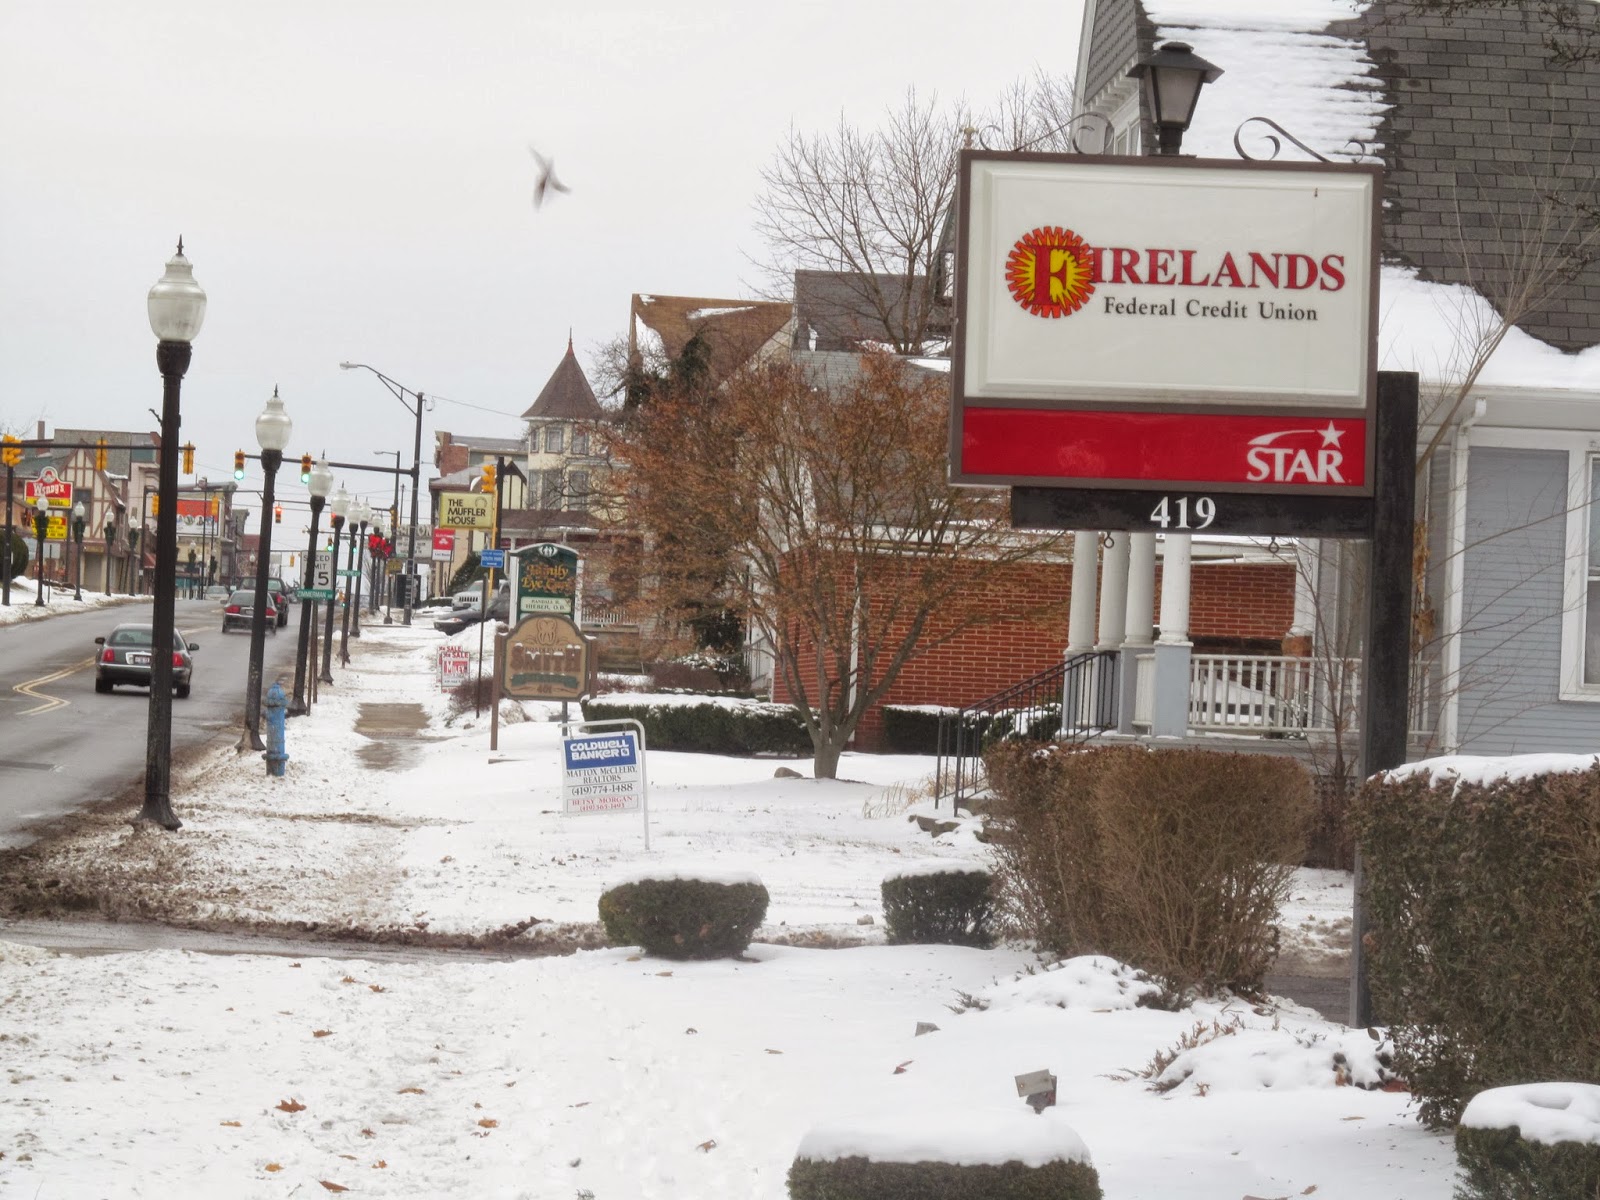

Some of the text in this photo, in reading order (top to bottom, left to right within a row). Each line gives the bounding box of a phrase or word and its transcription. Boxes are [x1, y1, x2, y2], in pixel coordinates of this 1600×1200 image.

[1023, 245, 1346, 306] FIRELANDS
[1104, 297, 1319, 321] Federal Credit Union
[1246, 446, 1346, 484] STAR
[448, 498, 463, 507] THE
[447, 508, 486, 517] MUFFLER
[1150, 496, 1216, 530] 419
[447, 516, 476, 525] HOUSE
[570, 739, 629, 752] COLDWELL
[571, 748, 620, 760] BANKER
[567, 768, 598, 778] MATTOX
[584, 774, 622, 784] REALTORS
